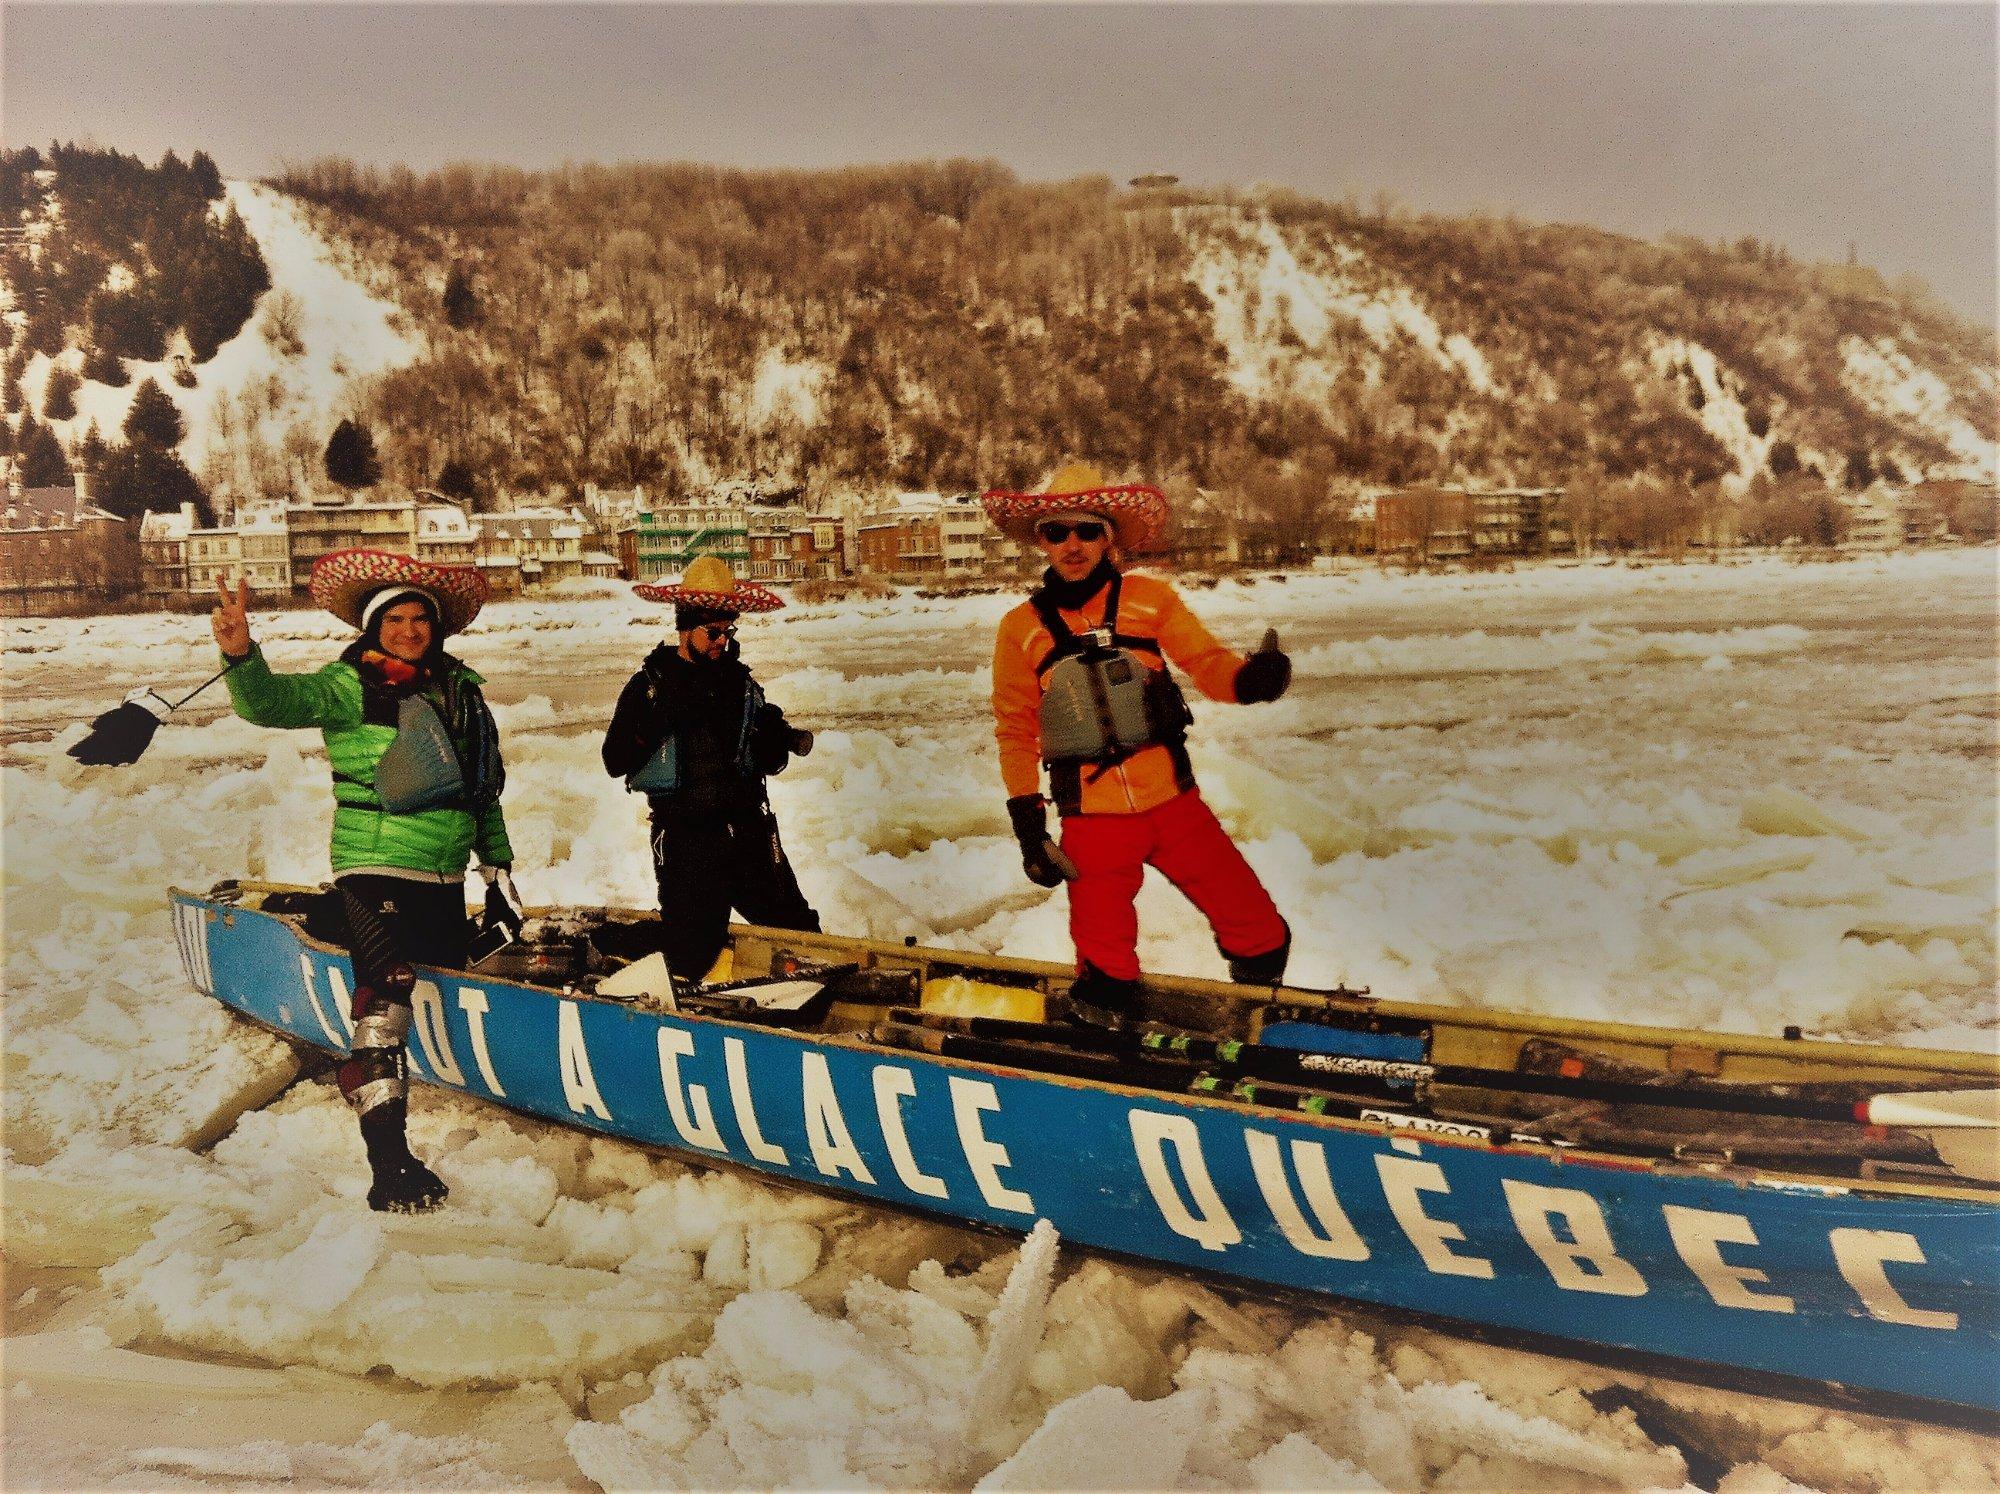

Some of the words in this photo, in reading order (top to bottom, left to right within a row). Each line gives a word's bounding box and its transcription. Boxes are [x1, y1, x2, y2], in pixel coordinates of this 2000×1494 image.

[300, 953, 507, 1098] COT
[558, 1000, 612, 1121] A
[657, 1026, 1036, 1214] GLACE
[1128, 1108, 1958, 1331] QUÉBEC
